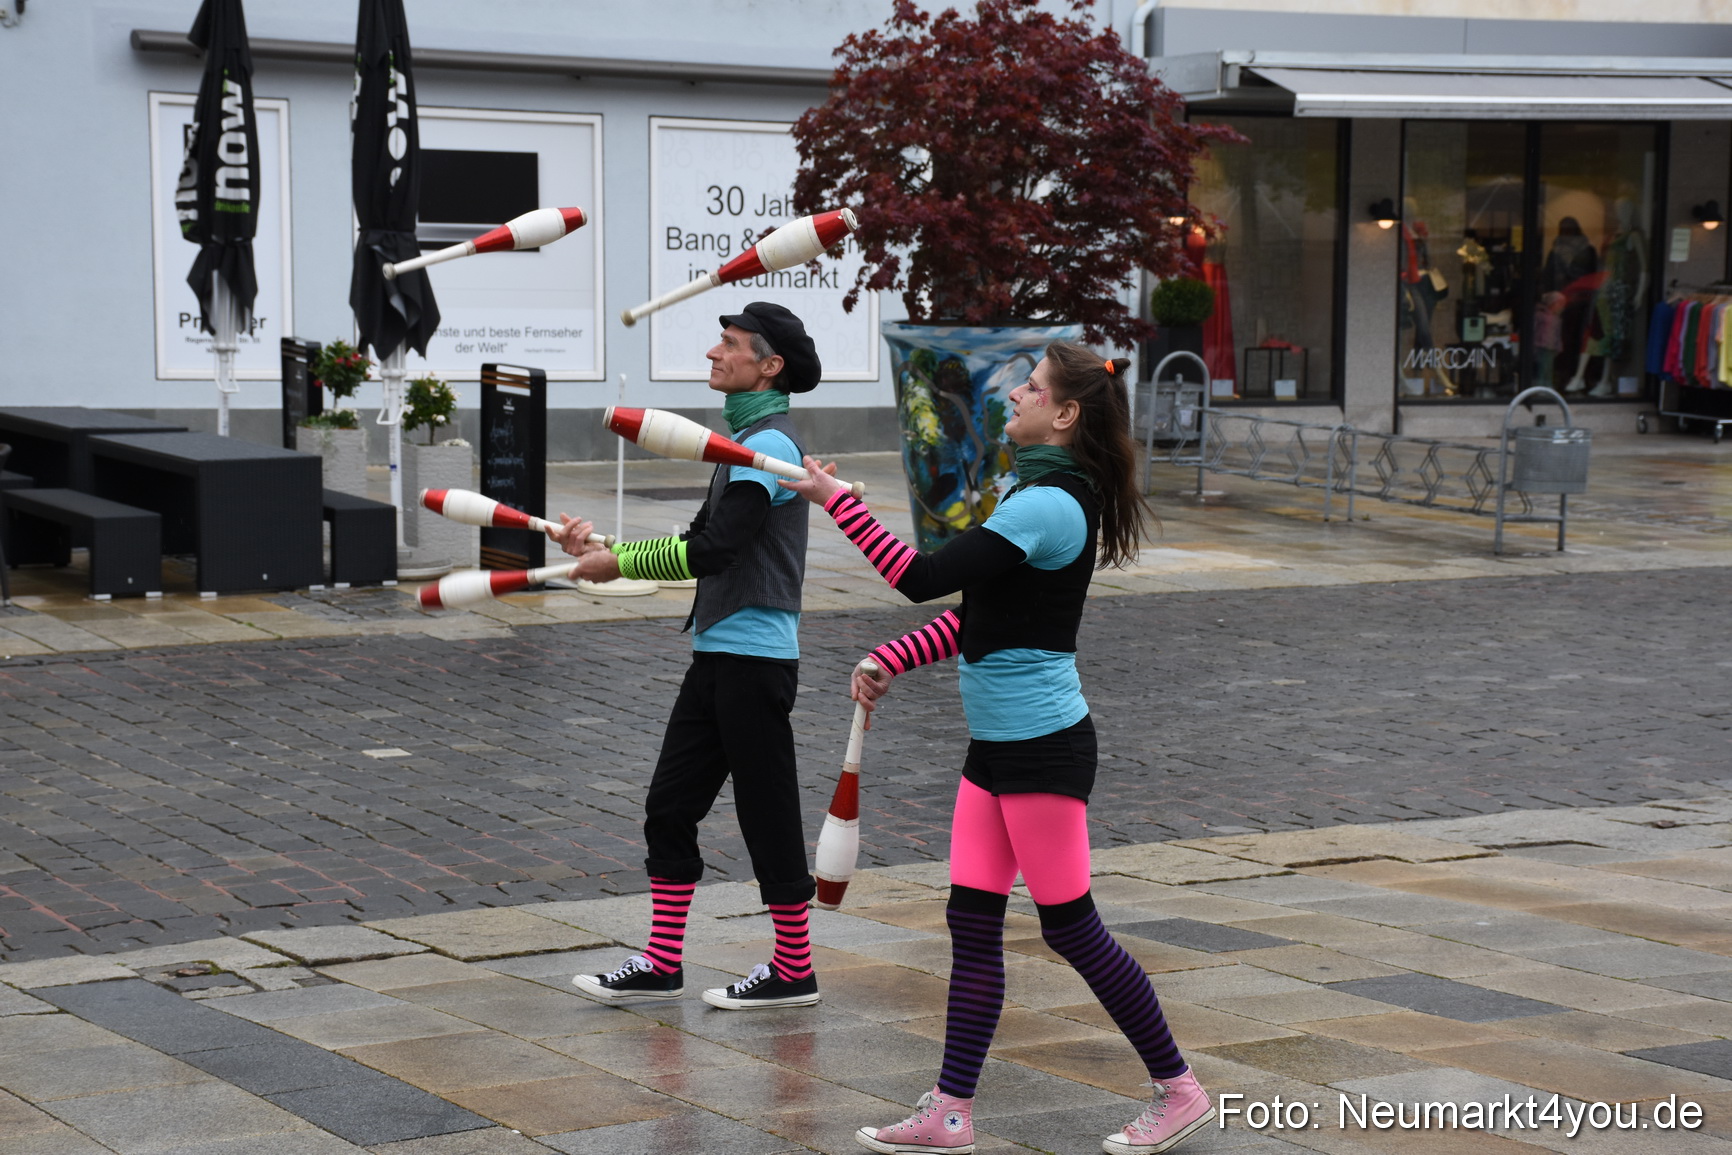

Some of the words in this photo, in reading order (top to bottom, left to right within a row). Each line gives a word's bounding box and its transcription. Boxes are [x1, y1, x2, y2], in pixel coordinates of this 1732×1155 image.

[706, 184, 745, 216] 30
[666, 226, 731, 258] Bang
[741, 227, 758, 251] &
[464, 327, 486, 338] und
[489, 327, 521, 338] beste
[524, 326, 583, 338] Fernseher
[454, 342, 474, 354] der
